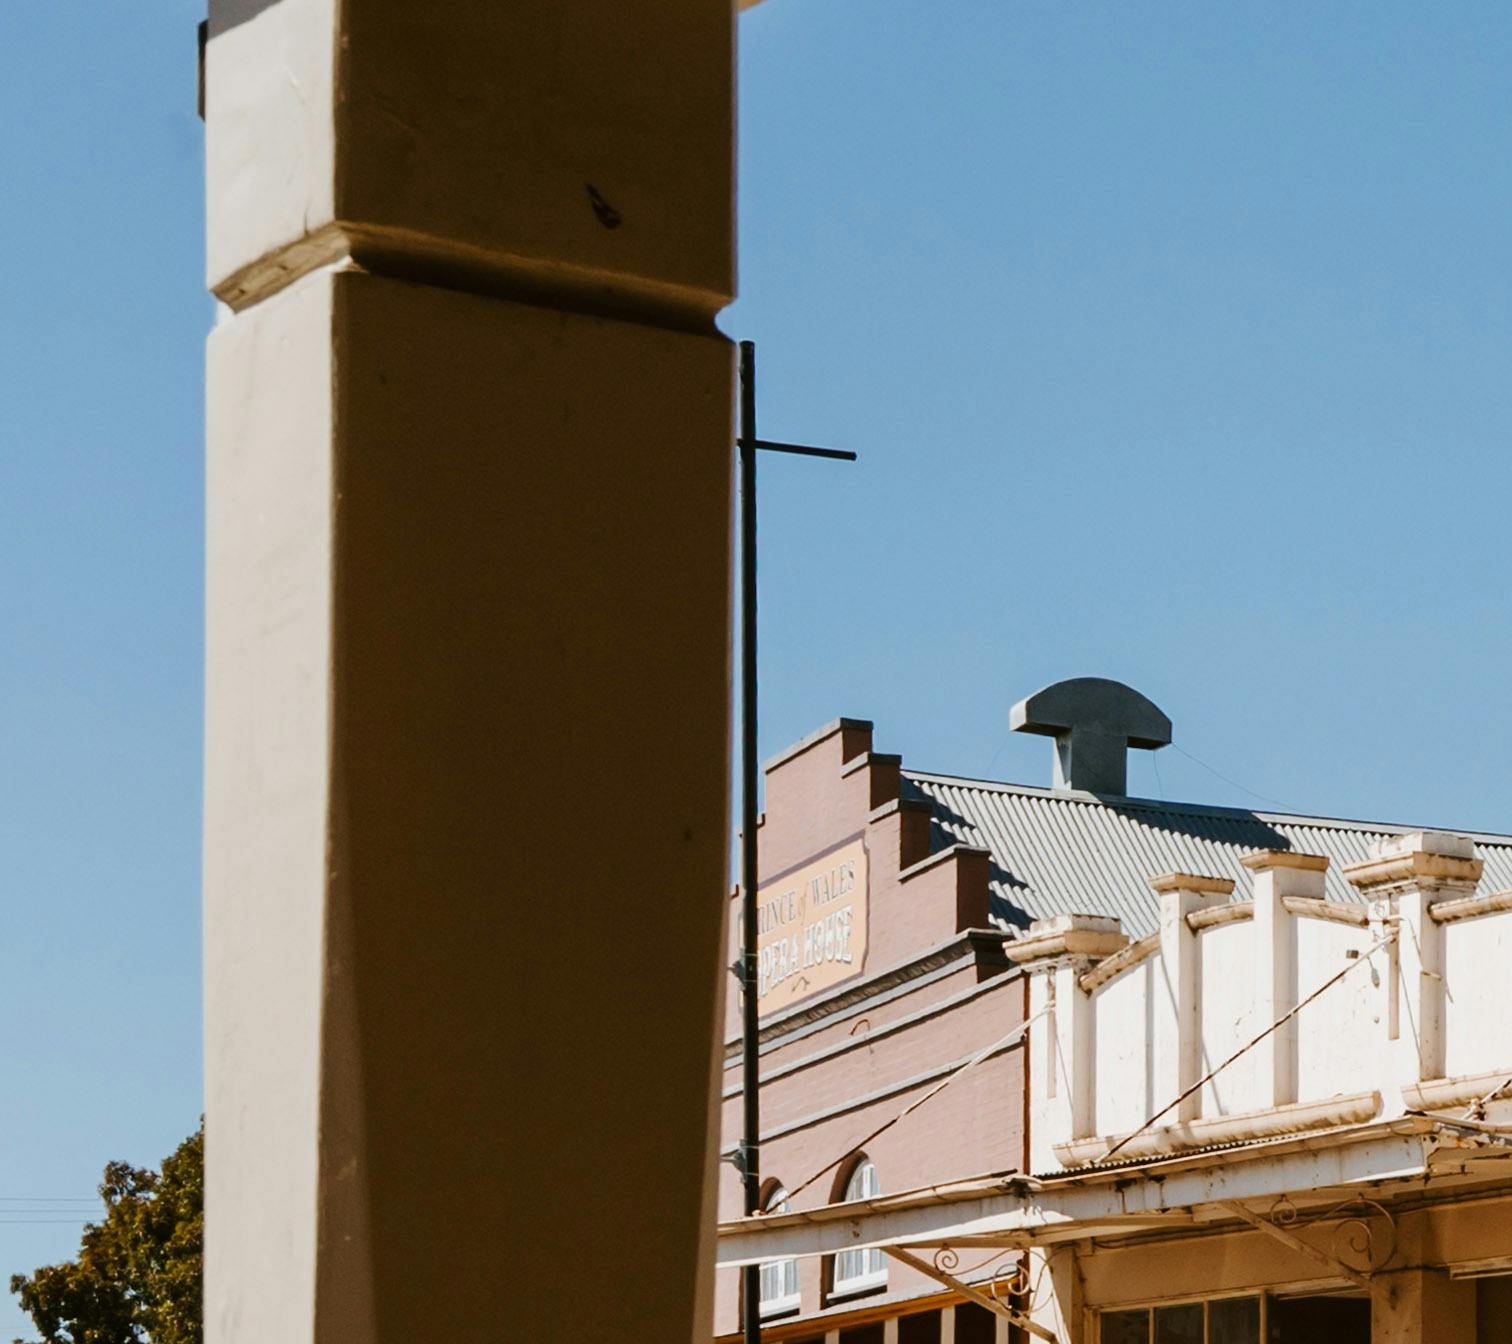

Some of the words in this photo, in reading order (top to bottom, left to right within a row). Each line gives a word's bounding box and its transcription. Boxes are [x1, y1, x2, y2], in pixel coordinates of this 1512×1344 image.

[757, 891, 796, 936] RINCE
[811, 859, 856, 906] WALES
[759, 932, 800, 998] PERA
[803, 905, 852, 969] HOUSE
